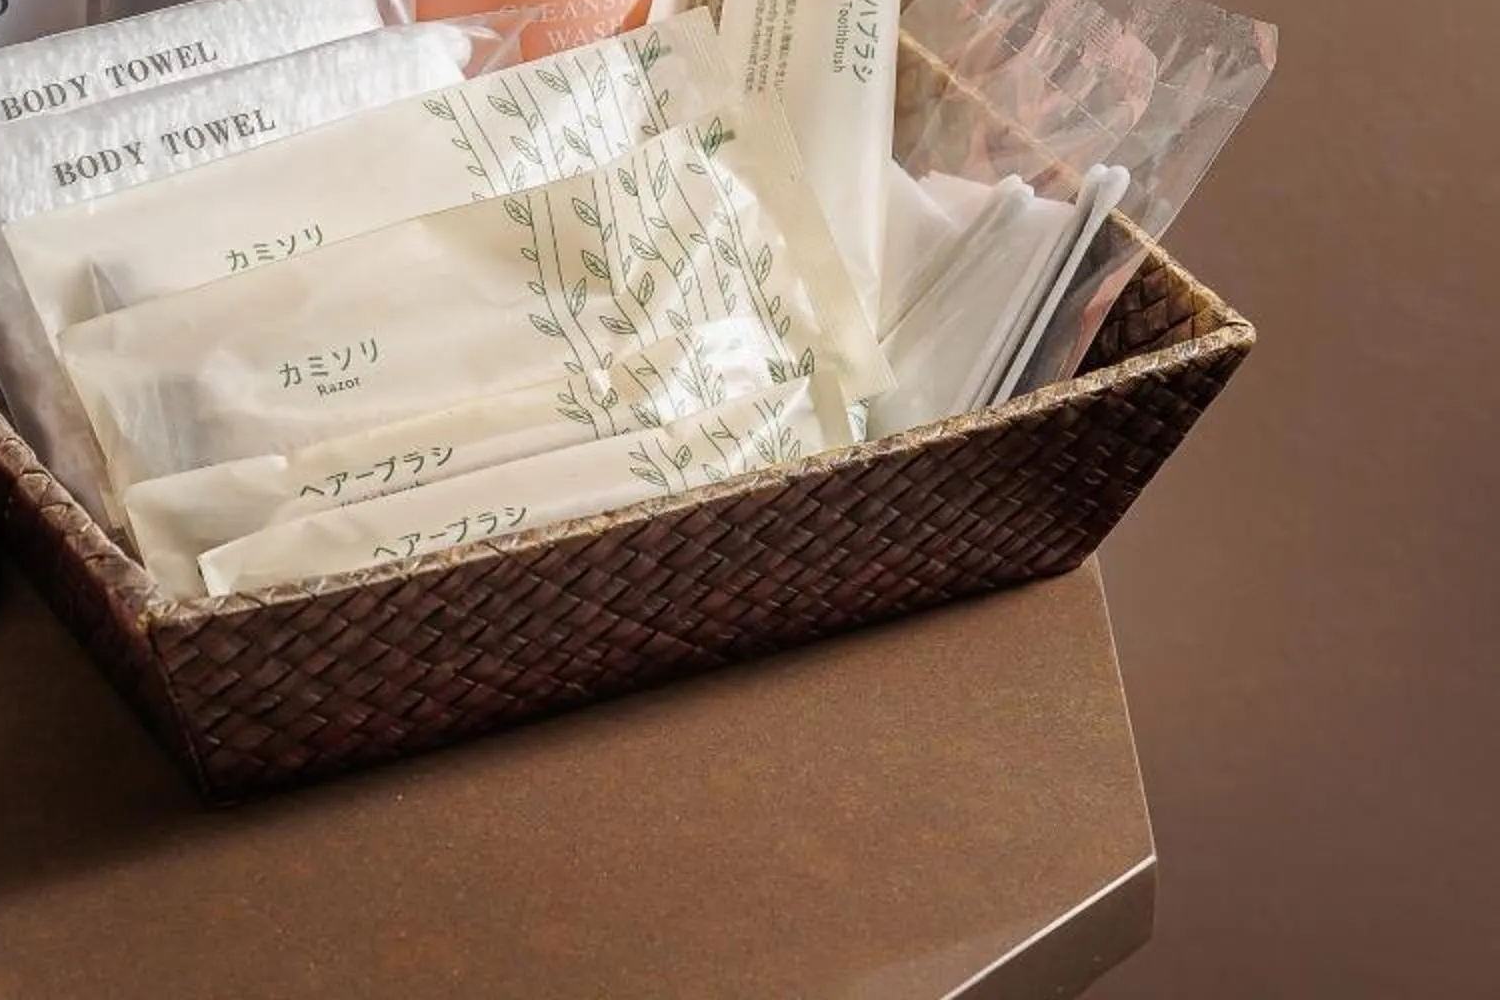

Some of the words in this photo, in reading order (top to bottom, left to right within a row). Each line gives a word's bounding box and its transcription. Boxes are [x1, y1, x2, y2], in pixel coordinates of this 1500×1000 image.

[833, 1, 853, 74] Toothbrush
[1, 75, 88, 120] BODY
[105, 40, 218, 88] TOWEL
[53, 142, 146, 187] BODY
[161, 109, 277, 155] TOWEL
[226, 224, 324, 271] カミソリ
[279, 338, 378, 388] カミソリ
[317, 376, 362, 397] Razor
[300, 447, 453, 498] ヘアーブラシ
[373, 506, 527, 557] ヘアーブラシ
